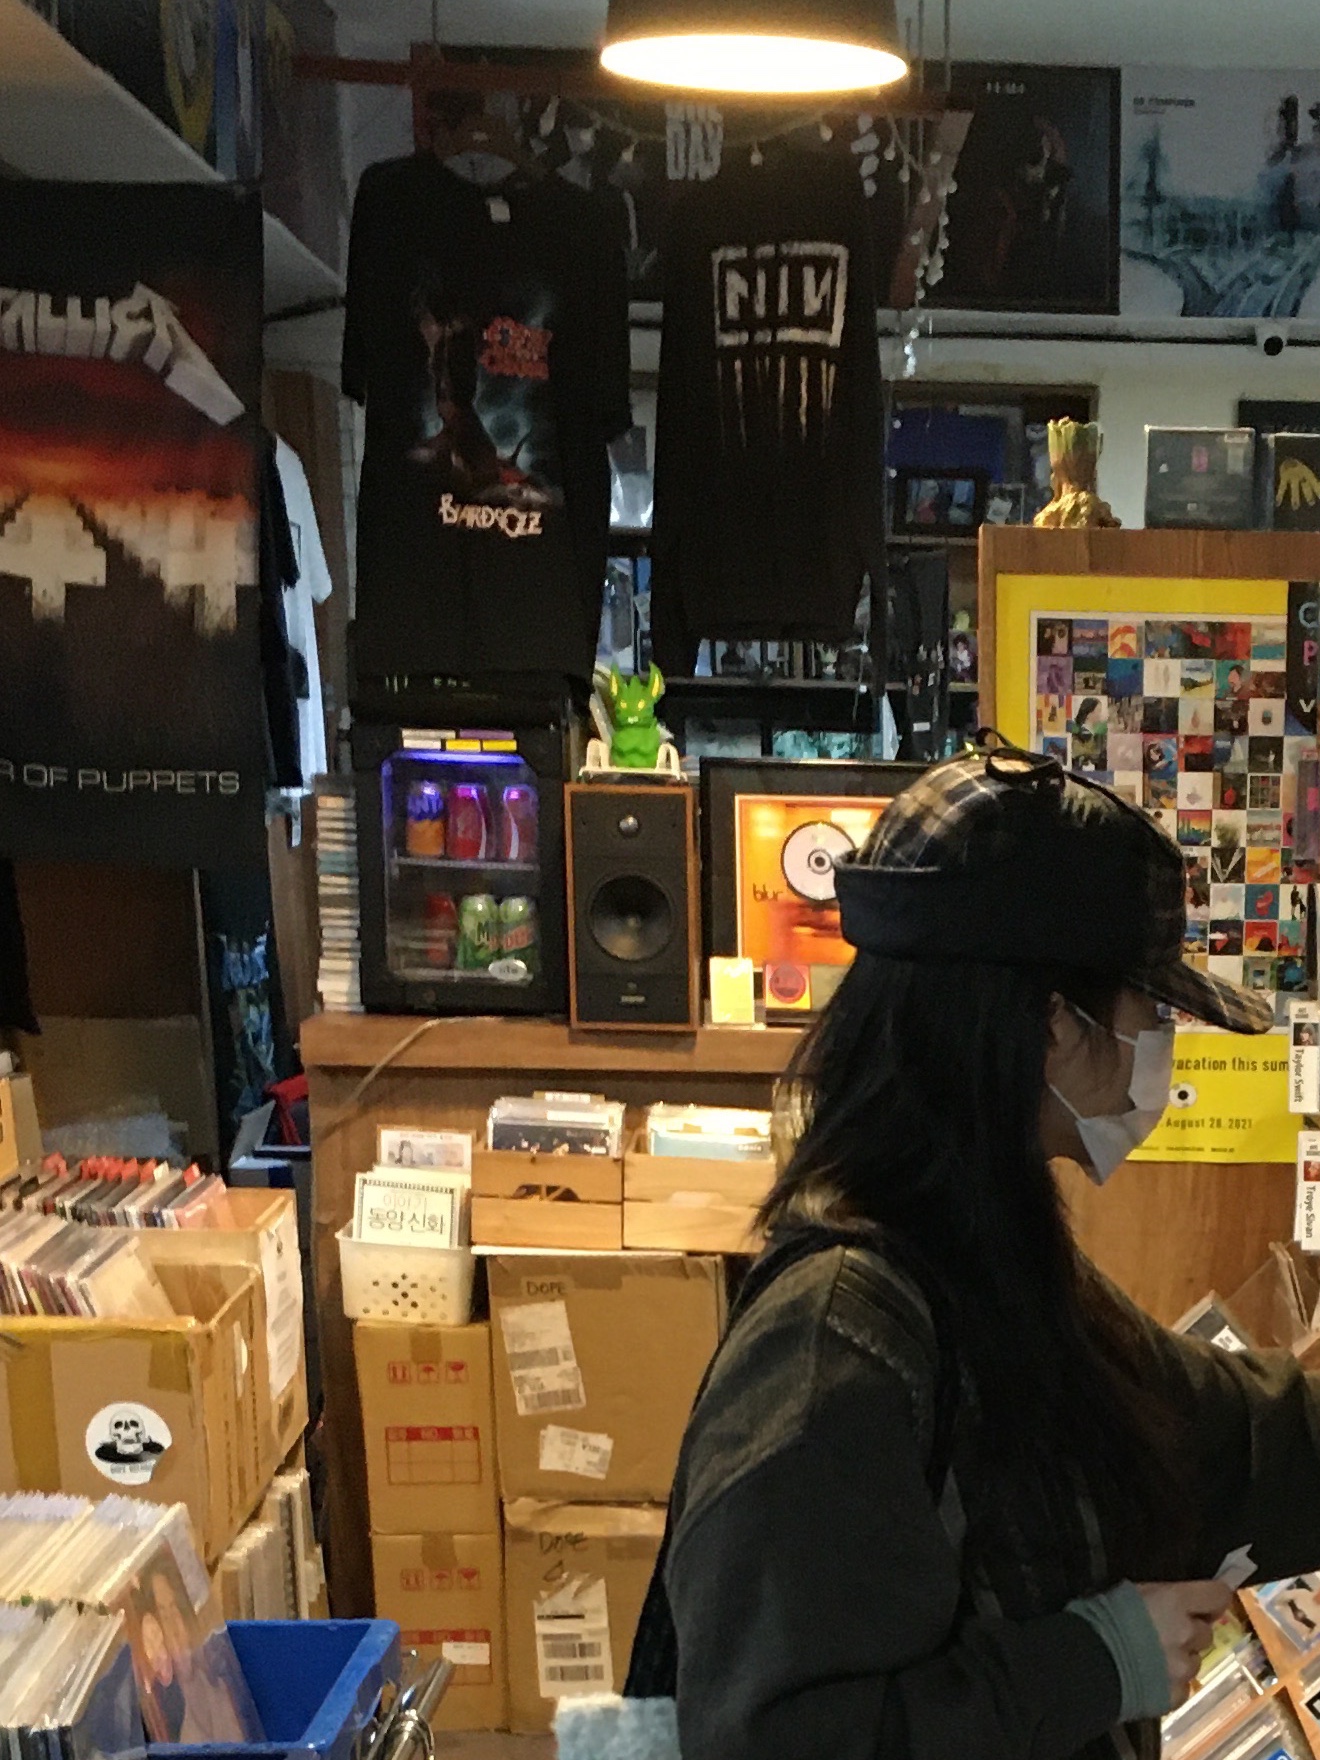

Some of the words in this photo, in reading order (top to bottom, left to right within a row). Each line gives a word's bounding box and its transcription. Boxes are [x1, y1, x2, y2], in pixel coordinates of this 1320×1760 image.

[23, 762, 69, 789] OF
[78, 768, 240, 794] PUPPETS
[1232, 1057, 1257, 1071] this
[1294, 1049, 1305, 1075] Taylor
[1293, 1077, 1304, 1103] Swift
[1166, 1117, 1205, 1130] August
[1307, 1186, 1316, 1210] Troye
[1305, 1211, 1315, 1239] Sivan
